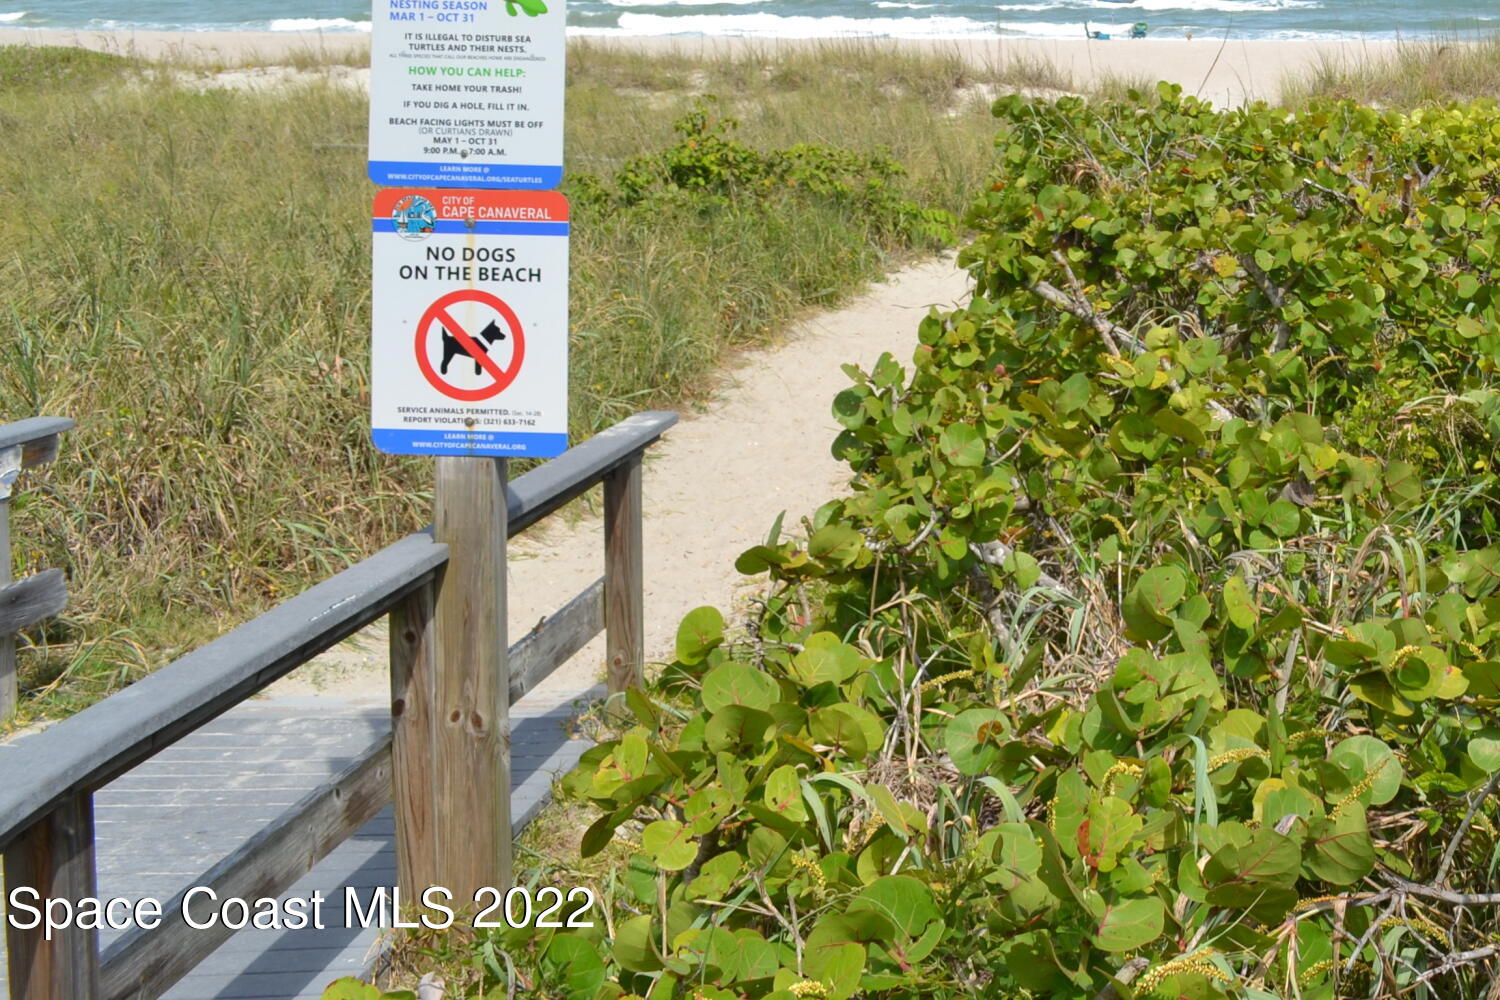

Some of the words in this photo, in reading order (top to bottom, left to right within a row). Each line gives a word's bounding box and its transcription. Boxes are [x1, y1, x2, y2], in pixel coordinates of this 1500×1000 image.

[390, 0, 439, 10] NESTING
[442, 1, 488, 11] SEASON
[390, 12, 415, 21] MAR
[420, 13, 424, 21] 1
[436, 13, 460, 22] OCT
[462, 14, 474, 22] 31
[425, 34, 459, 42] ILLEGAL
[462, 34, 473, 42] TO
[476, 34, 512, 42] DISTURB
[515, 35, 531, 43] SEA
[409, 44, 445, 52] TURTLES
[448, 44, 467, 52] AND
[470, 44, 495, 52] THEIR
[498, 46, 527, 54] NESTS.
[408, 66, 437, 76] HOW
[440, 66, 464, 76] YOU
[467, 67, 492, 77] CAN
[494, 68, 526, 78] HELP:
[435, 84, 461, 92] HOME
[490, 86, 522, 94] TRASH!
[403, 100, 411, 108] IF
[434, 101, 449, 109] DIG
[460, 102, 485, 110] HOLE,
[517, 103, 530, 111] IN.
[389, 117, 418, 126] BEACH
[420, 118, 452, 126] FACING
[454, 119, 485, 127] LIGHTS
[487, 120, 512, 128] MUST
[527, 121, 544, 129] OFF
[418, 127, 434, 135] (OR
[478, 128, 513, 137] DRAWN)
[442, 196, 461, 205] CITY
[462, 196, 474, 205] OF
[442, 206, 474, 218] CAPE
[478, 207, 552, 220] CANAVERAL
[426, 246, 455, 261] NO
[462, 248, 516, 262] DOGS
[400, 265, 428, 280] ON
[435, 266, 472, 281] THE
[478, 267, 542, 282] BEACH
[397, 406, 427, 414] SERVICE
[429, 407, 464, 415] ANIMALS
[466, 408, 510, 416] PERMITTED.
[434, 417, 482, 425] VIOLATIS:
